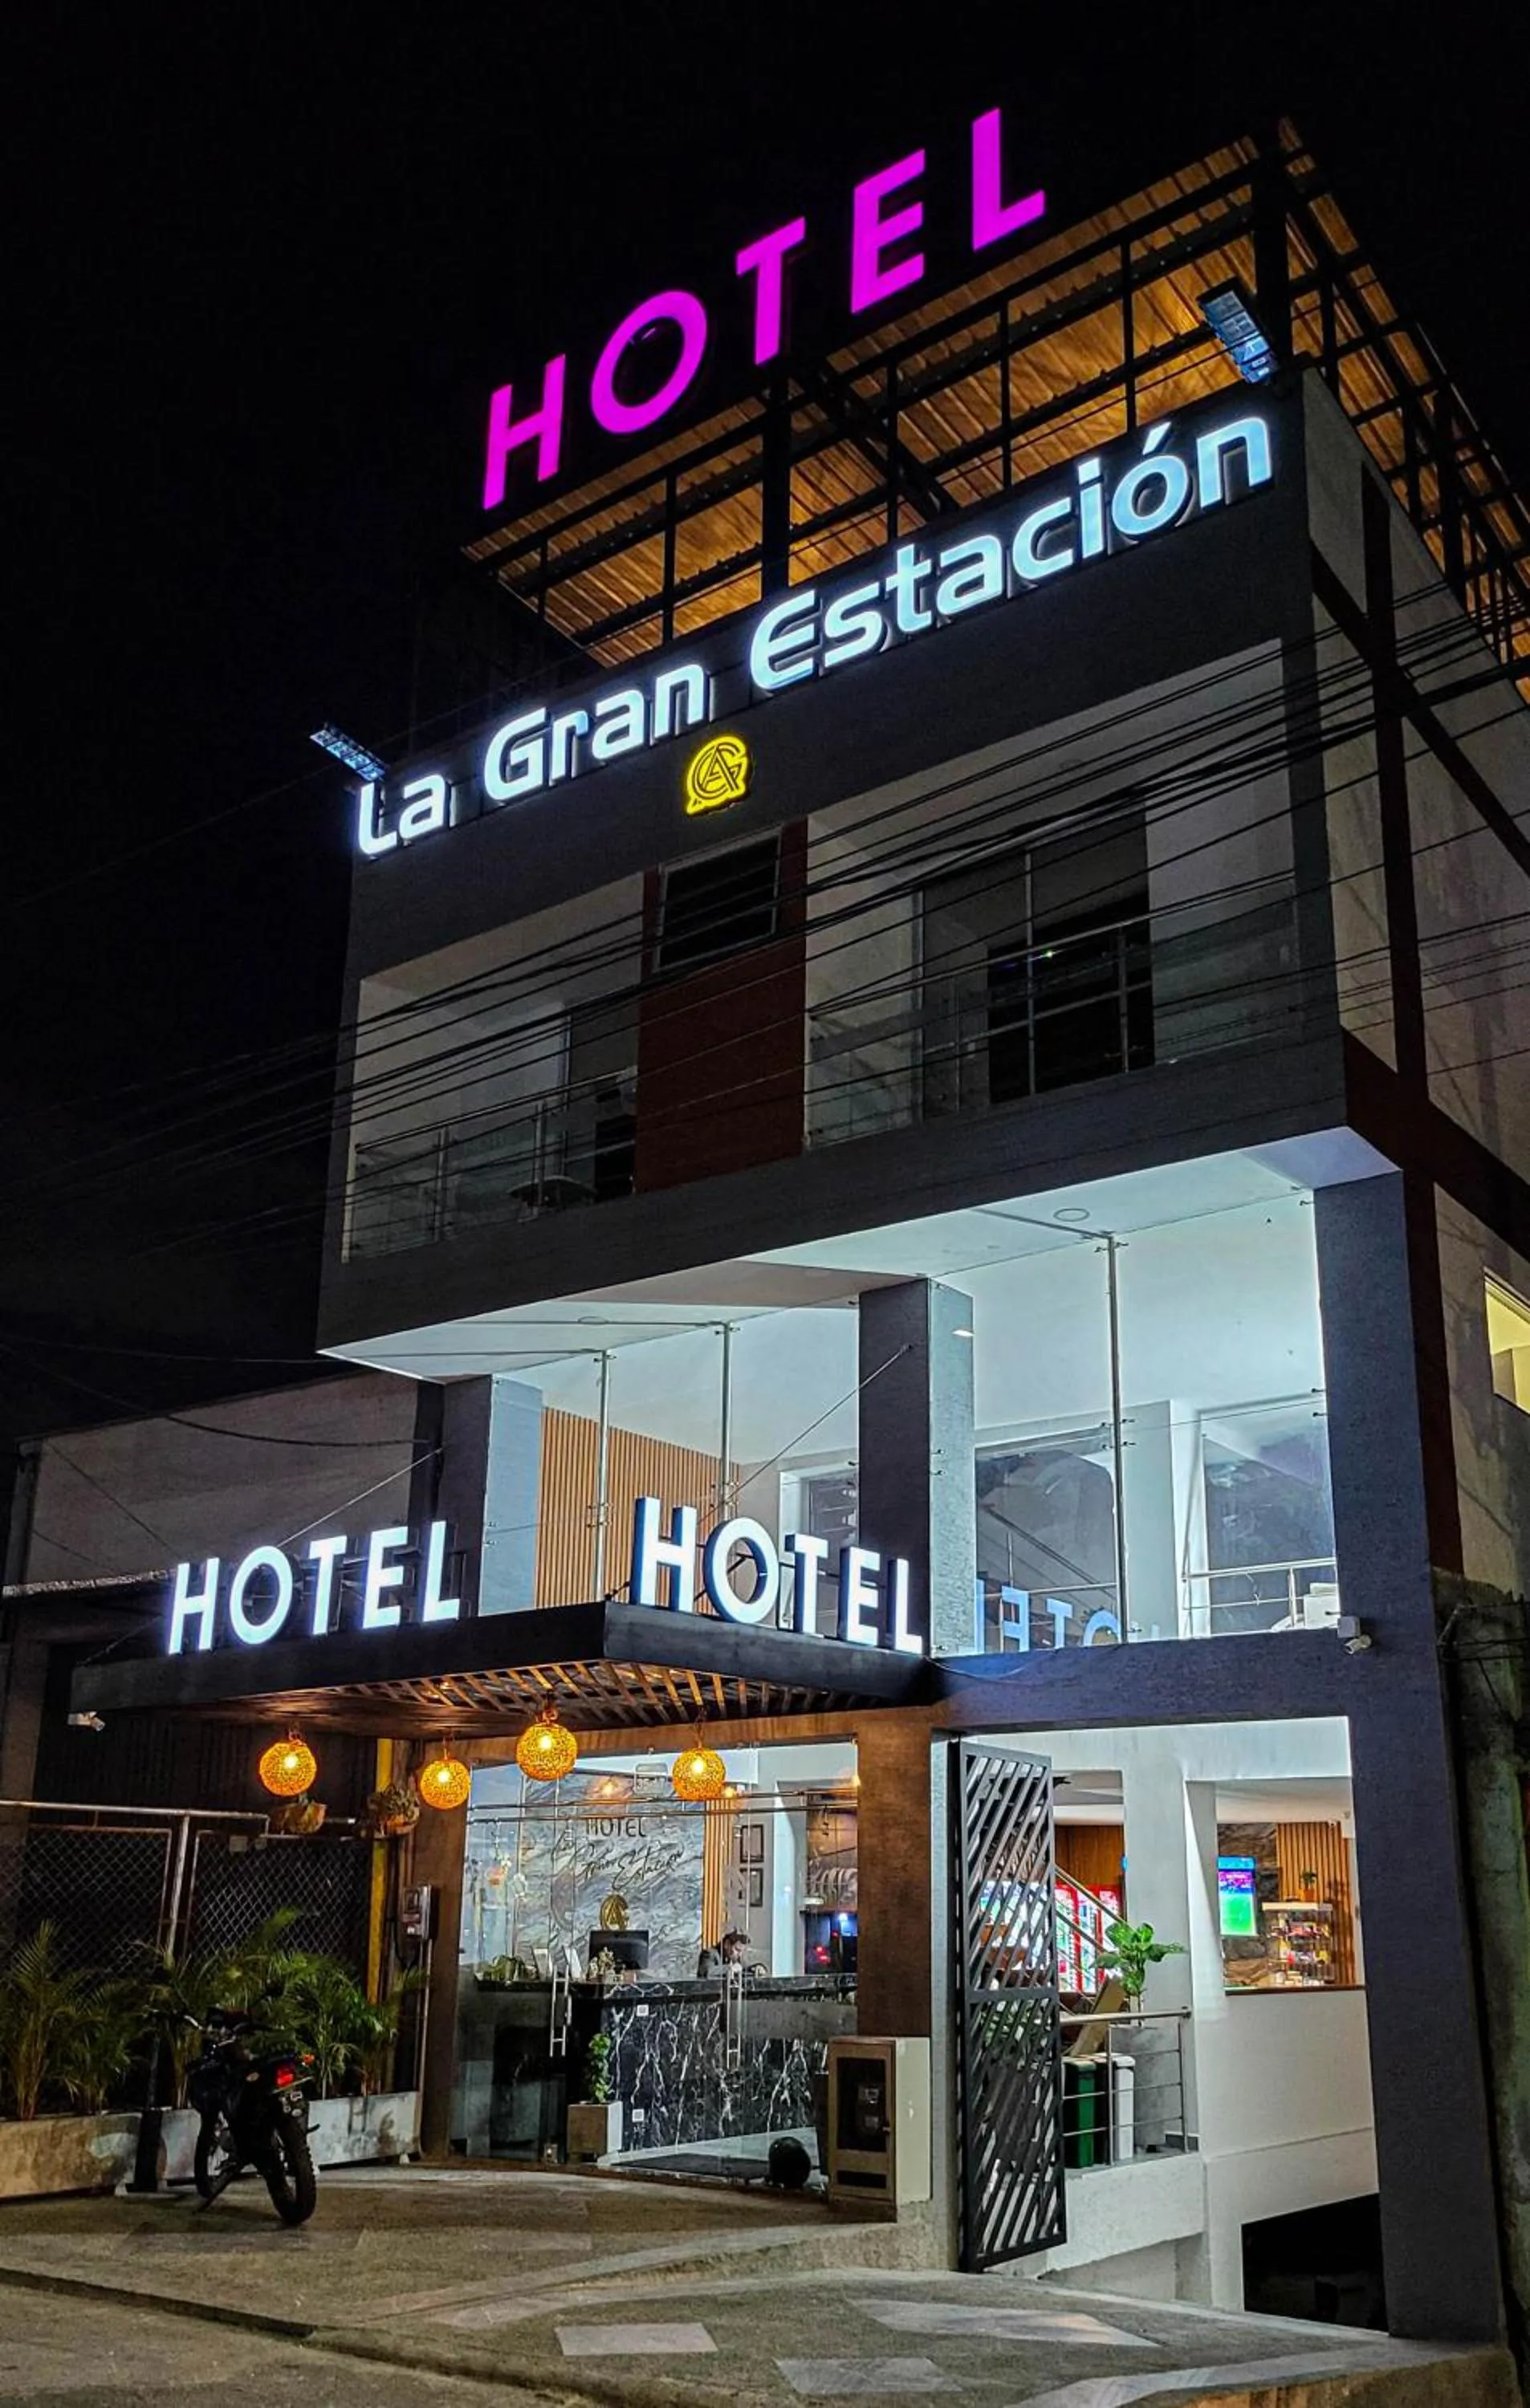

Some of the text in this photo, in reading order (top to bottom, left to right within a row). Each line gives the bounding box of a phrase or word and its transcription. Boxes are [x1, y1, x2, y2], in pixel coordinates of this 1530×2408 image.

[483, 108, 1046, 509] HOTEL
[357, 416, 1273, 856] La Gran Estación
[169, 1521, 460, 1654] HOTEL
[630, 1496, 923, 1654] HOTEL
